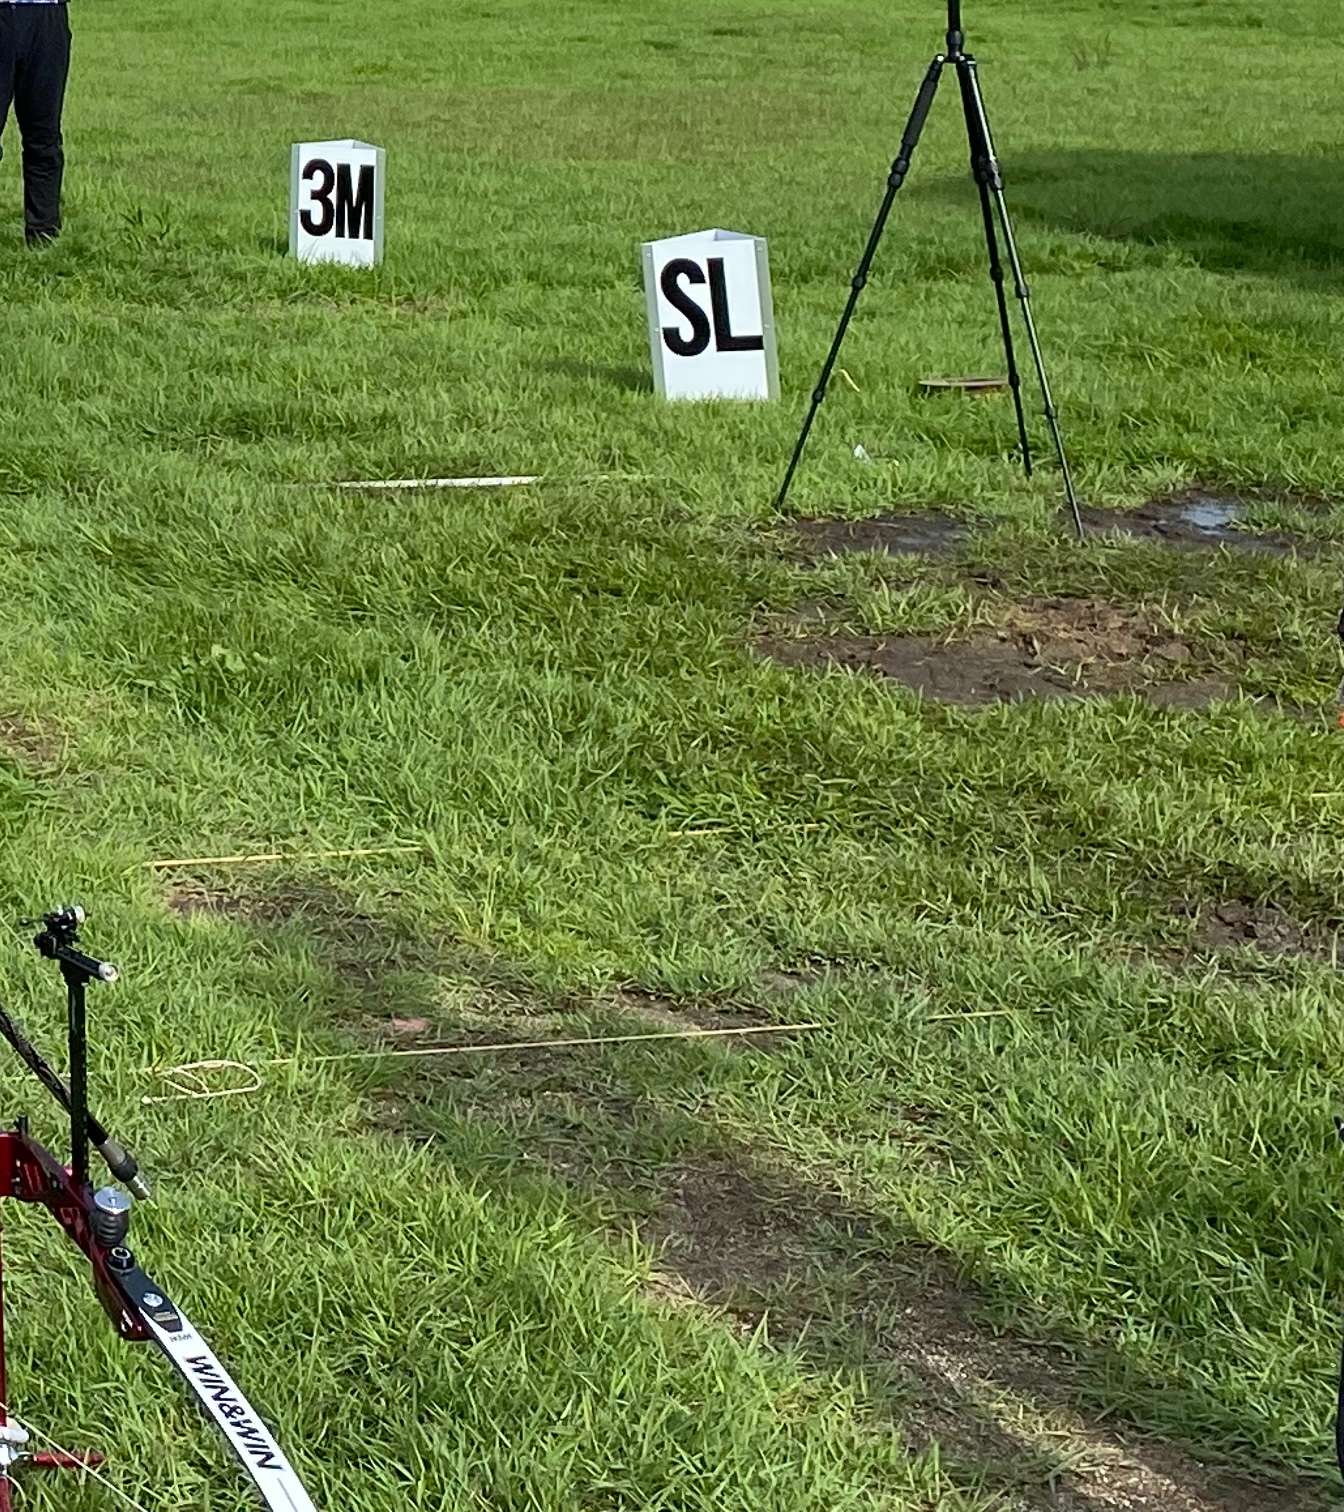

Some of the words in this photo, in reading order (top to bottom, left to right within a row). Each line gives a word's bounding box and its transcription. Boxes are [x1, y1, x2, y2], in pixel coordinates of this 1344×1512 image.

[299, 158, 374, 240] 3M
[660, 257, 764, 357] SL
[185, 1355, 285, 1471] WIN&WIN
